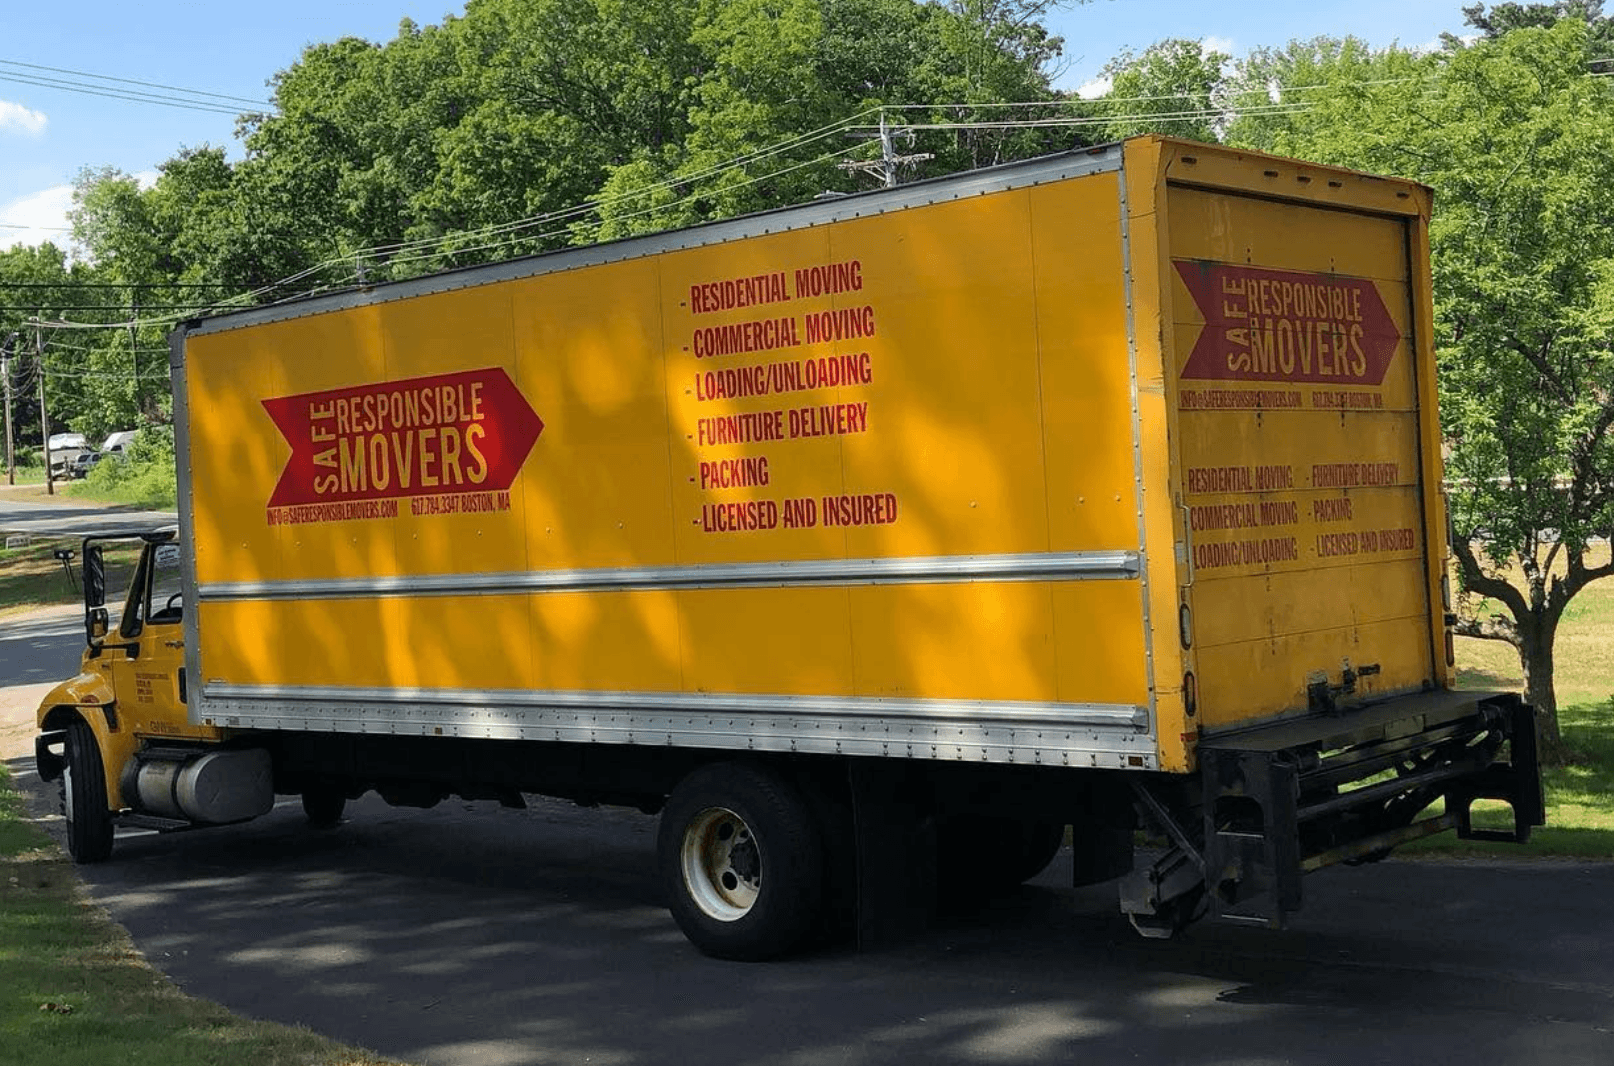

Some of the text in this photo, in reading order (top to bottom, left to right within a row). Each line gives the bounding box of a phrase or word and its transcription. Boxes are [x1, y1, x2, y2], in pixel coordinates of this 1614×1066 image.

[690, 260, 863, 314] RESIDENTIAL MOVING
[1249, 279, 1363, 321] RESPONSIBLE
[693, 306, 875, 358] COMMERCIAL MOVING
[1223, 277, 1250, 372] SAFE
[1252, 318, 1367, 377] MOVERS
[696, 352, 872, 401] LOADING/UNLOADING
[336, 382, 485, 434] RESPONSIBLE
[698, 402, 868, 446] FURNITURE DELIVERY
[310, 401, 339, 494] SAFE
[339, 423, 488, 493] MOVERS
[700, 456, 769, 489] PACKING
[1188, 465, 1294, 492] RESIDENTIAL MOVING
[1313, 463, 1398, 487] FURNITURE DELIVERY
[498, 491, 511, 510] MA
[703, 493, 898, 532] LICENSED AND INSURED
[1190, 501, 1298, 531] COMMERCIAL MOVING
[1313, 498, 1352, 522] PACKING
[1193, 537, 1298, 570] LOADING/UNLOADING
[1316, 528, 1414, 557] LICENSED AND INSURED
